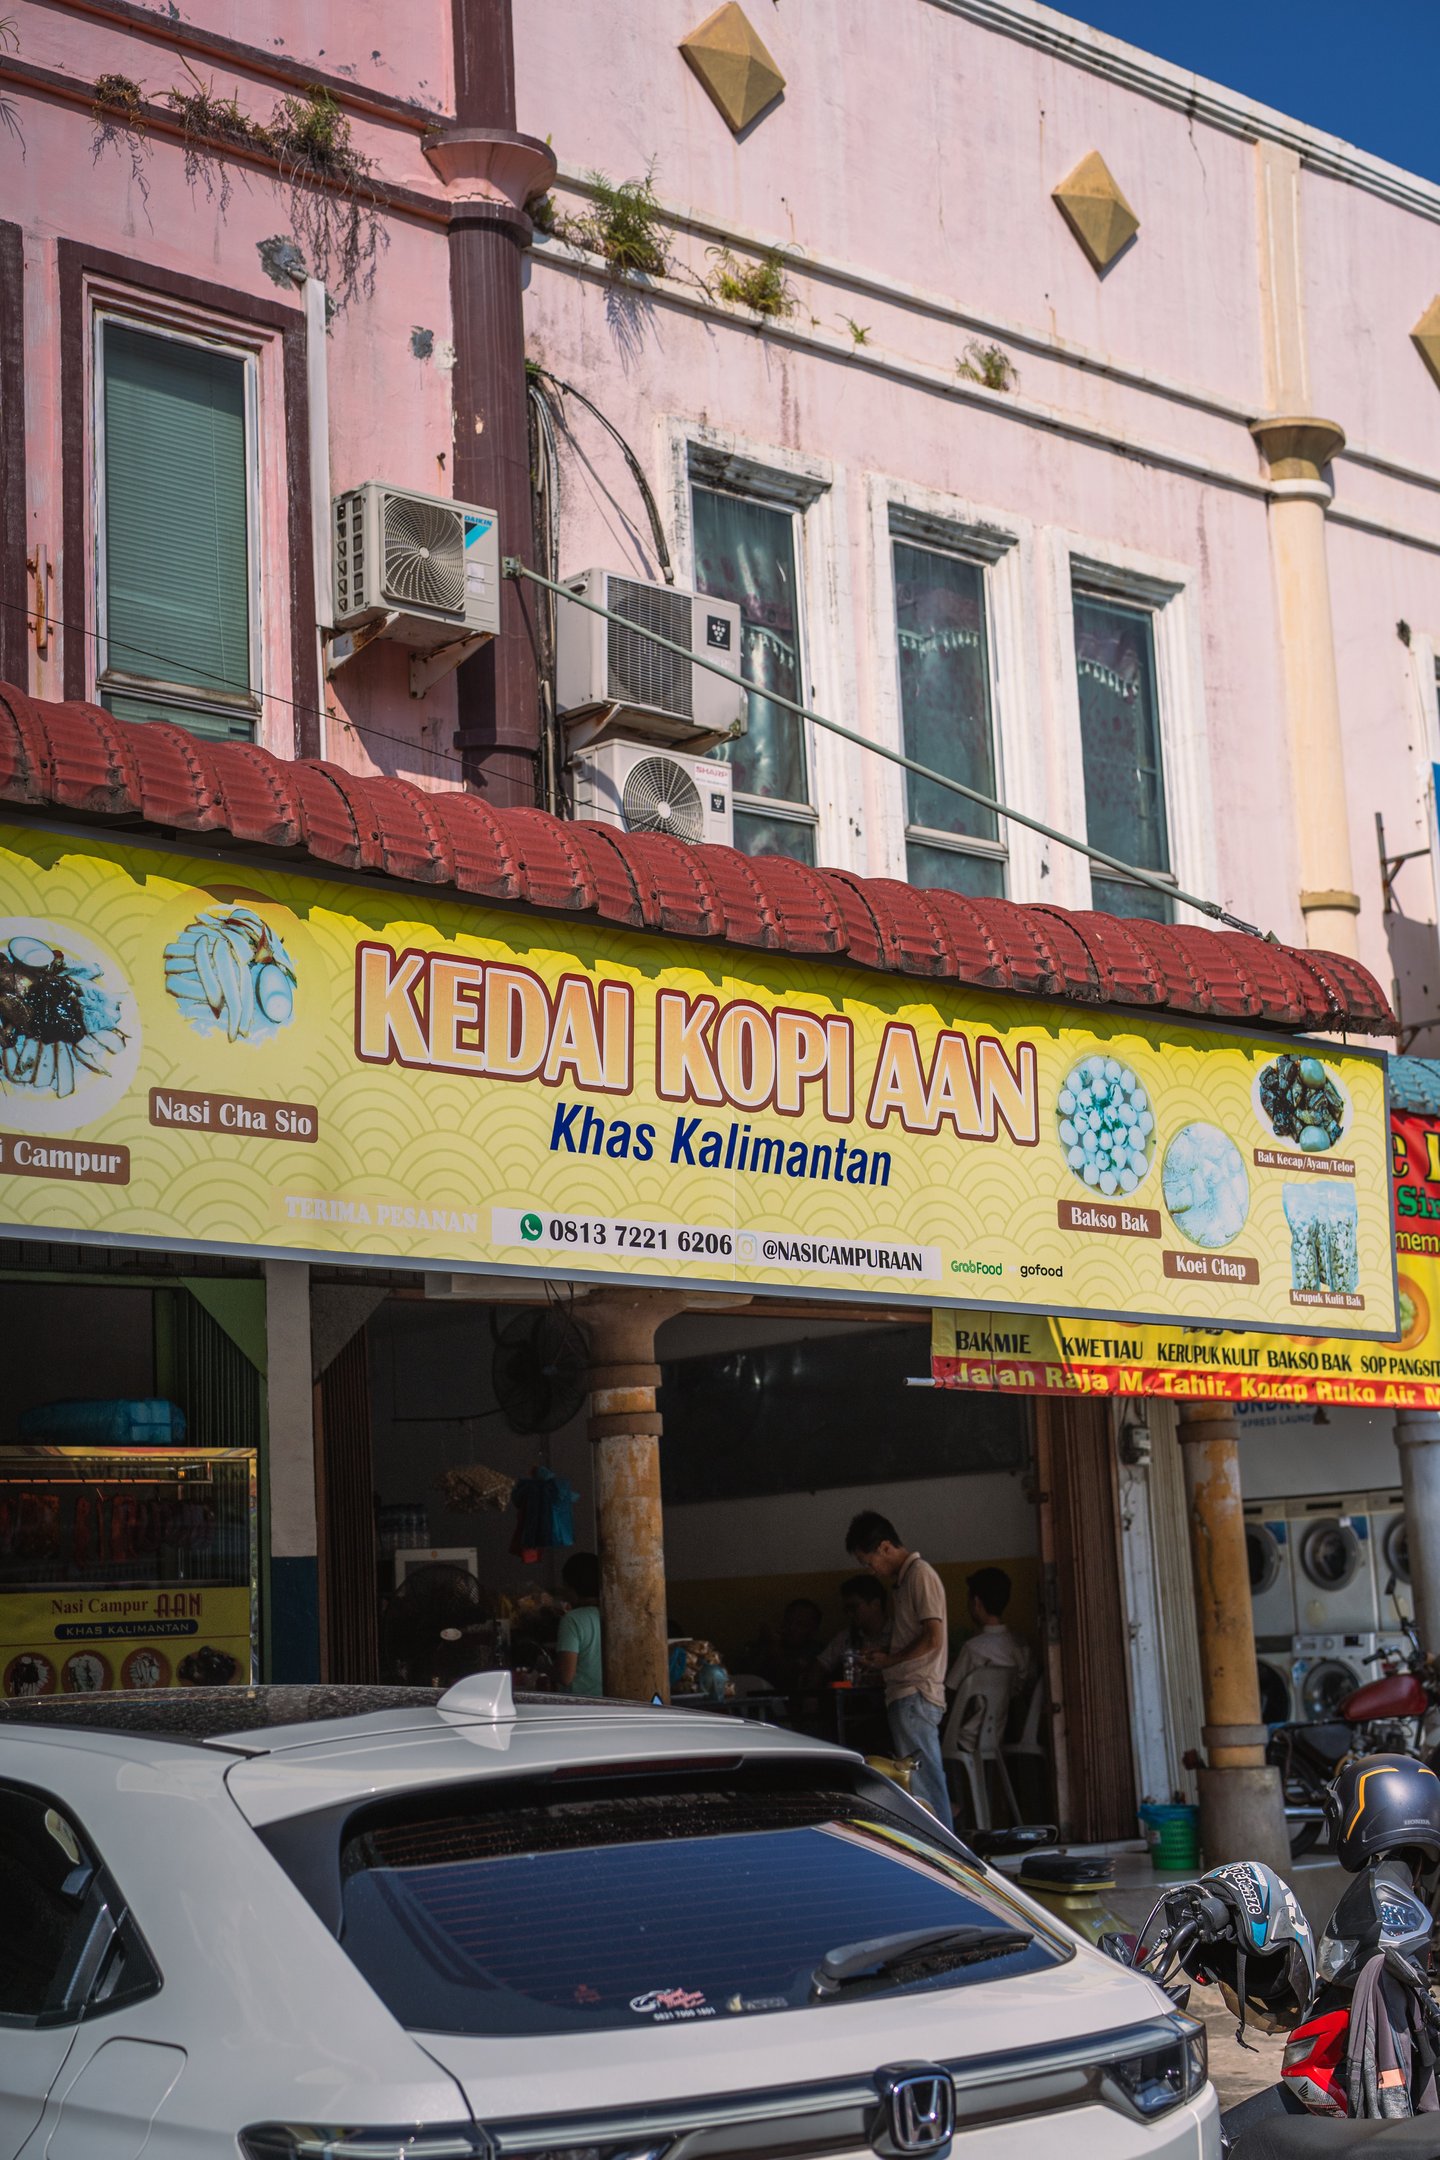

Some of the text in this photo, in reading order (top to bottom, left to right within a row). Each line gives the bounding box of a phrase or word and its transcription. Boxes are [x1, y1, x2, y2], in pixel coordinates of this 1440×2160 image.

[355, 941, 1039, 1147] KEDAI KOPI AAN
[155, 1095, 312, 1135] Nasi Cha Sio
[13, 1140, 121, 1176] Campur
[550, 1102, 892, 1187] Khas Kalimantan
[1257, 1151, 1355, 1174] Bak Kecap/Ayam/Telor
[284, 1195, 478, 1233] TERIMA PESANAN
[1071, 1207, 1150, 1232] Bakso Bak
[548, 1218, 732, 1256] 0813 7221 6206
[762, 1239, 923, 1272] @NASICAMPURAAN
[951, 1260, 1003, 1276] GrabFood
[1020, 1264, 1063, 1278] gofood
[1176, 1255, 1246, 1280] Koei Chap
[1292, 1291, 1361, 1307] Krupuk Kulit Bak
[955, 1331, 1031, 1354] BAKMIE
[1062, 1337, 1143, 1359] KWETIAU
[1158, 1343, 1219, 1365] KERUPUK
[1222, 1348, 1261, 1366] KULIT
[1268, 1350, 1319, 1370] BAKSO
[1323, 1354, 1352, 1372] BAK
[1361, 1356, 1387, 1374] SOP
[954, 1363, 1036, 1387] Jalan
[1045, 1367, 1109, 1393] Raja
[1119, 1371, 1153, 1392] M.
[1159, 1373, 1231, 1397] Tahir.
[1241, 1377, 1308, 1402] Komp
[1316, 1381, 1375, 1402] Ruko
[1384, 1384, 1416, 1404] Air
[51, 1593, 203, 1617] Nasi Campur AAN
[66, 1623, 190, 1636] KHAS KALIMANTAN
